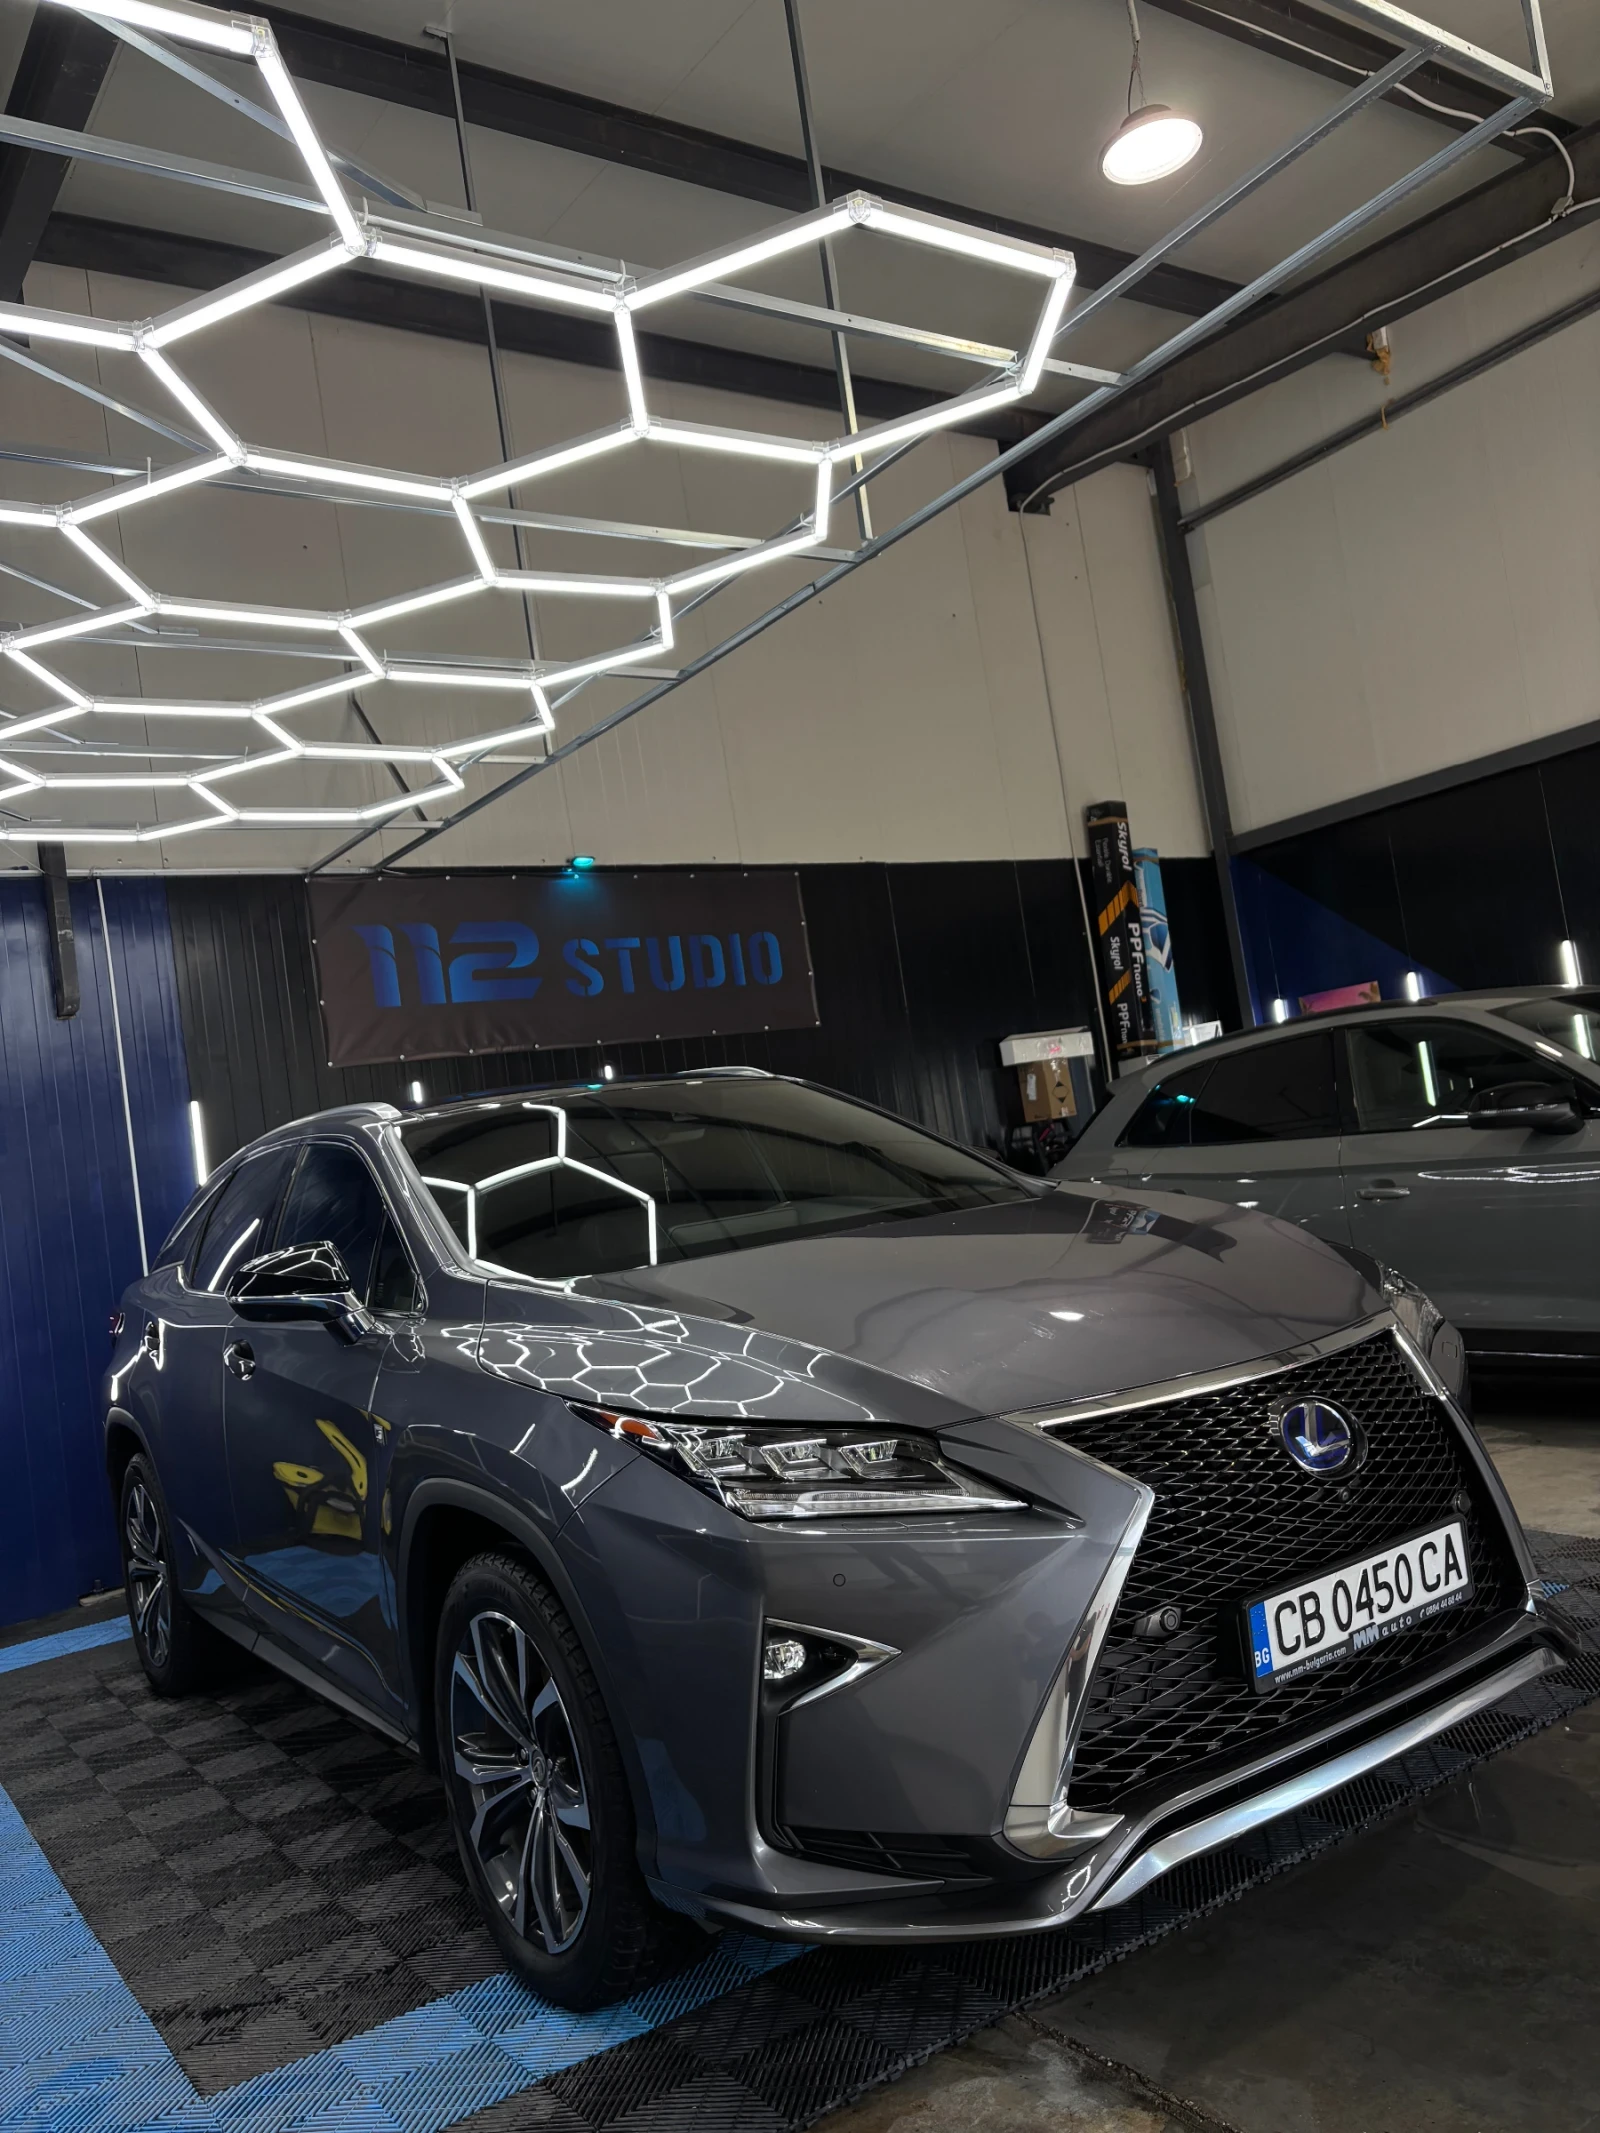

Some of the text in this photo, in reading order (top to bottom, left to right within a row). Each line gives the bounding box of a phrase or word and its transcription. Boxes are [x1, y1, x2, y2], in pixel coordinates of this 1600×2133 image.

[1117, 821, 1133, 872] Skyfol
[350, 921, 784, 1008] 112 STUDIO
[1109, 936, 1124, 970] Skyfol
[1274, 1533, 1463, 1656] CB 0450 CA
[1254, 1647, 1271, 1669] BG
[1274, 1646, 1347, 1684] www.mm-bulgaria.com
[1352, 1623, 1380, 1651] MM
[1381, 1615, 1413, 1637] auto
